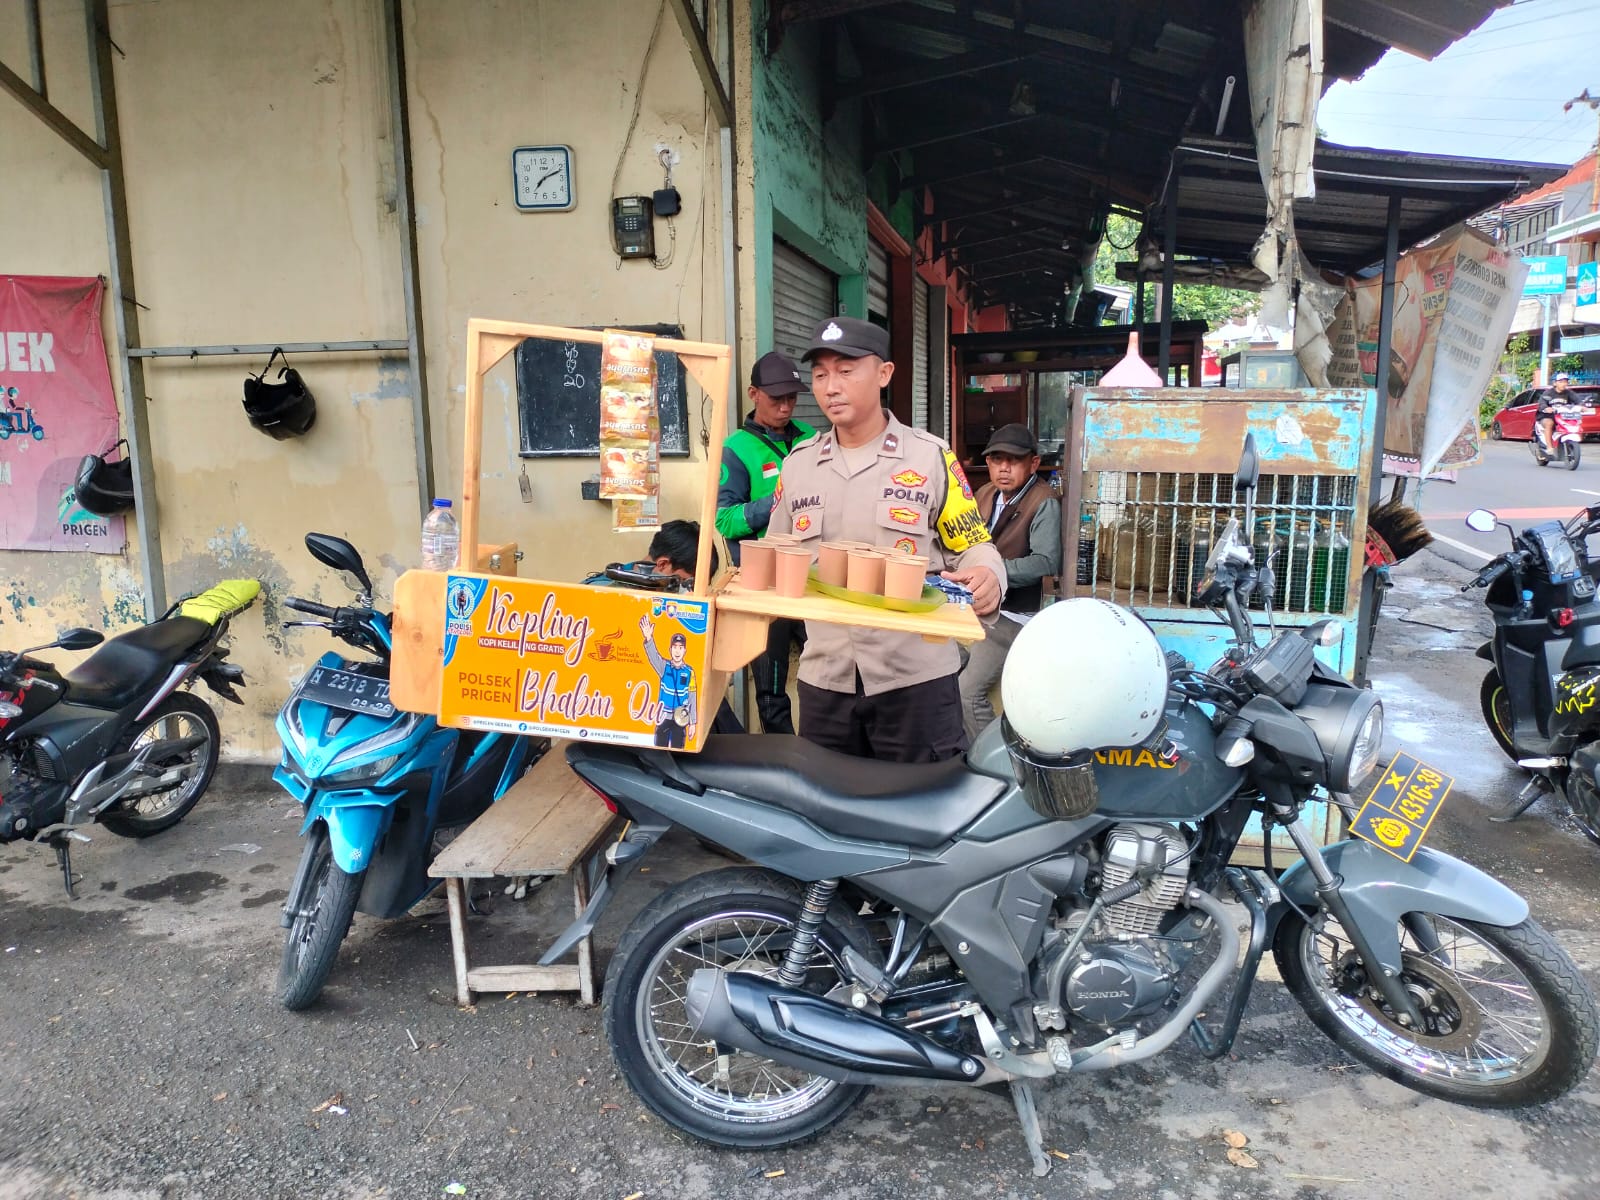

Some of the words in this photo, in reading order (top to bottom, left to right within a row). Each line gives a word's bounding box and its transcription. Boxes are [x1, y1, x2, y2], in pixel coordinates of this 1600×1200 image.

[540, 157, 548, 165] 12
[883, 487, 930, 505] POLRI
[62, 523, 107, 537] PRIGEN
[964, 528, 982, 540] KEL
[449, 622, 472, 632] POLISI
[486, 586, 593, 667] Kopling
[478, 638, 496, 648] KOPI
[497, 639, 537, 651] KELILNG
[537, 642, 565, 654] GRATIS
[310, 669, 325, 685] N
[327, 673, 368, 694] 2318
[458, 672, 513, 688] POLSEK
[461, 687, 512, 704] PRIGEN
[521, 669, 613, 722] Bhabin
[1385, 770, 1406, 791] X
[1398, 768, 1444, 821] 4316-39
[1077, 990, 1130, 999] HONDA
